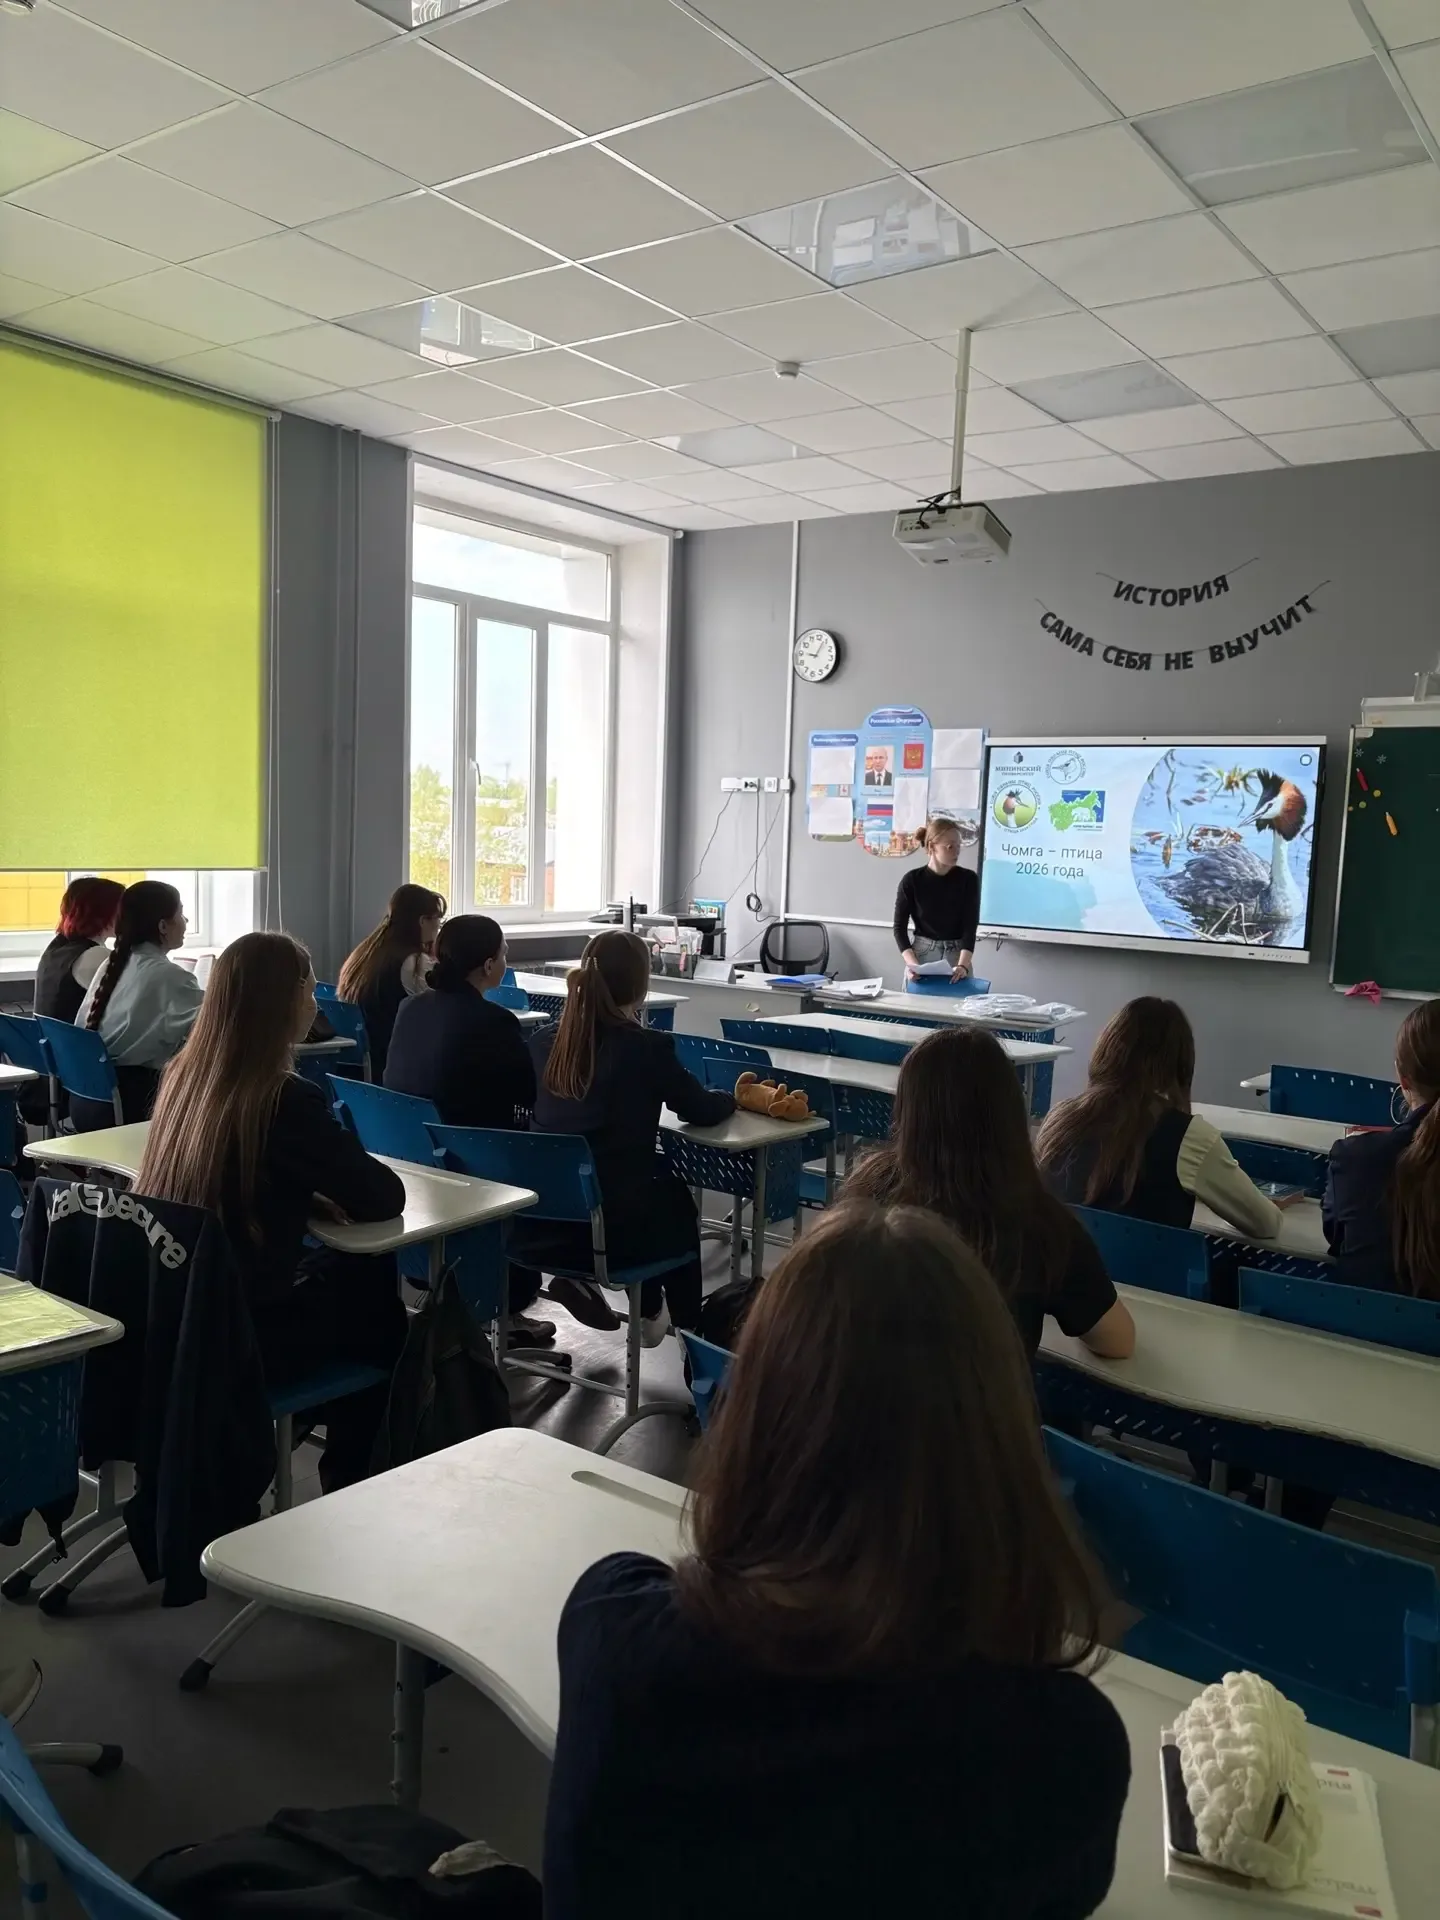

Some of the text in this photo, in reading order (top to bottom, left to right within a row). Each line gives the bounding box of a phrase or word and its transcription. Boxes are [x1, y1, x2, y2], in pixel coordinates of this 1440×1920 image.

[1113, 574, 1230, 608] ИСТОРИЯ
[1040, 594, 1317, 671] САМА СЕБЯ НЕ ВЫУЧИТ
[1001, 843, 1044, 857] Чомга
[1061, 848, 1103, 860] птица
[1016, 862, 1084, 879] 2026 года
